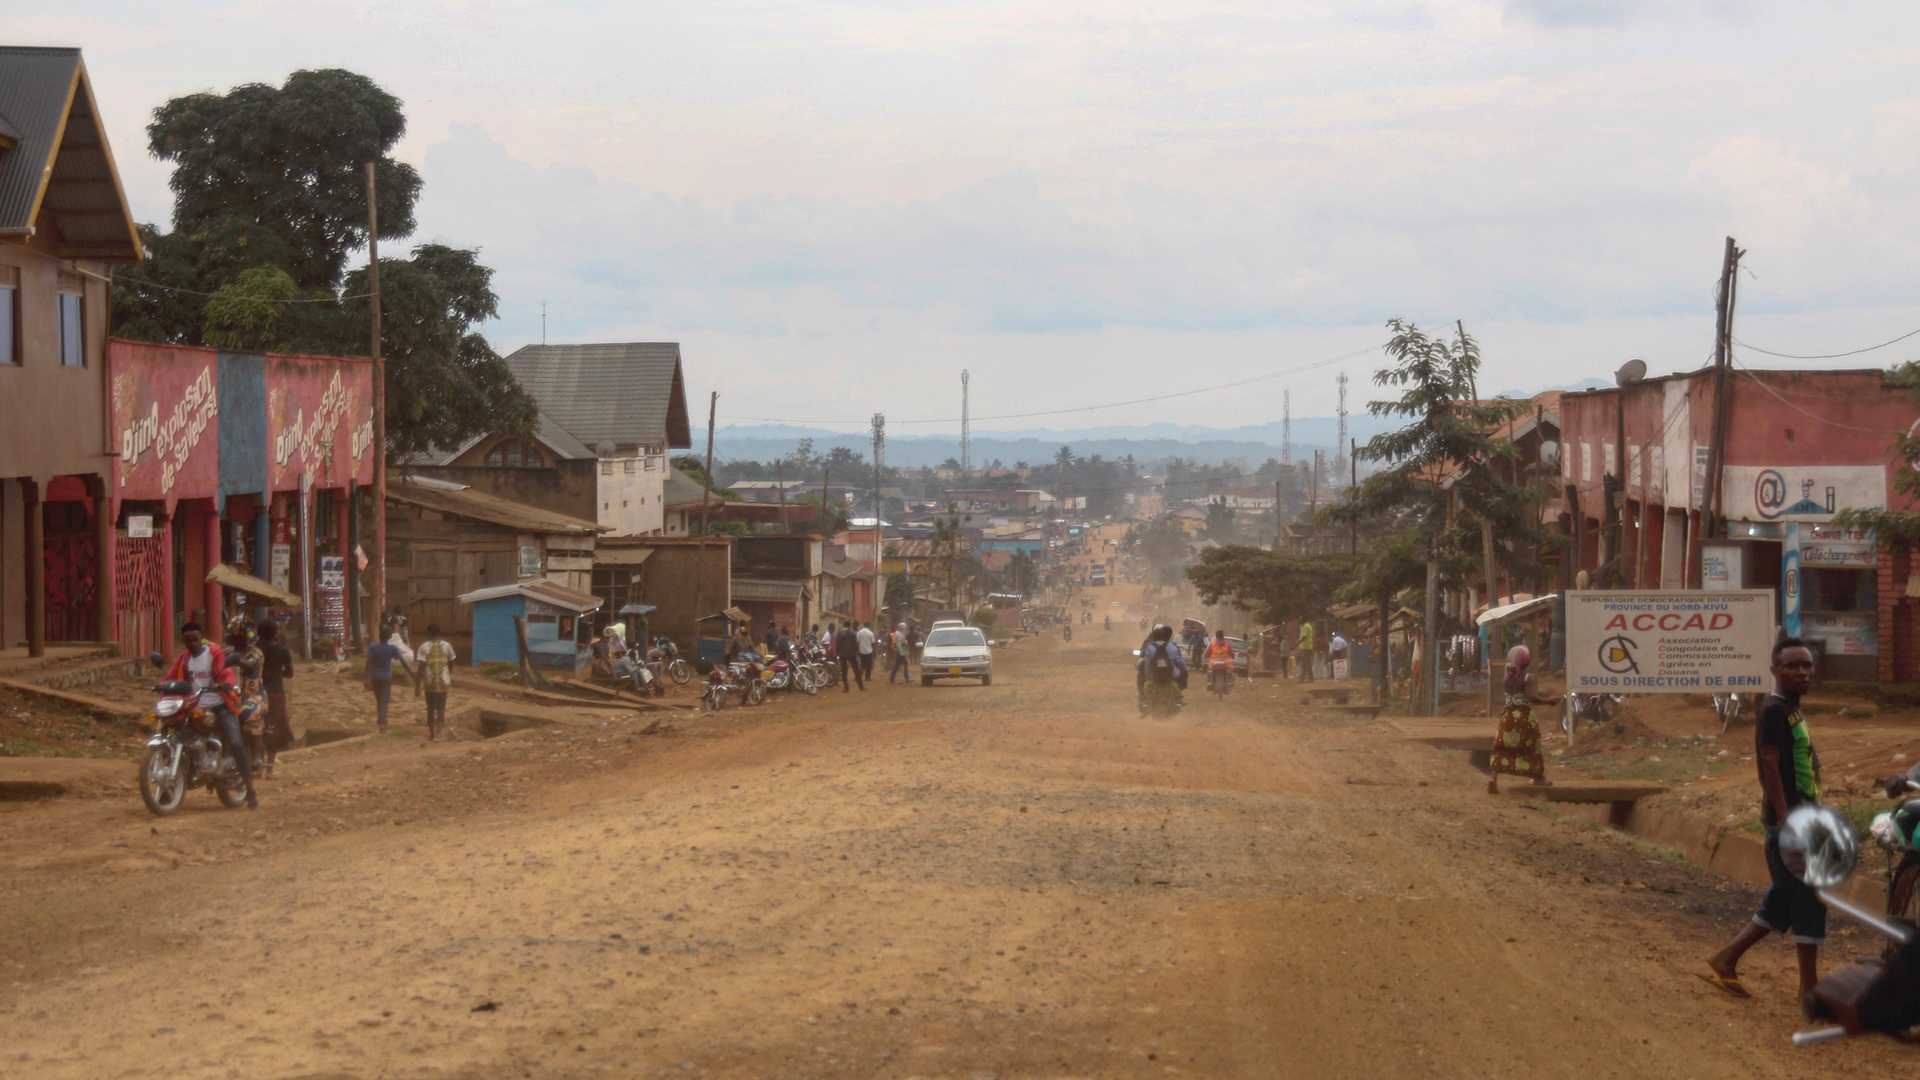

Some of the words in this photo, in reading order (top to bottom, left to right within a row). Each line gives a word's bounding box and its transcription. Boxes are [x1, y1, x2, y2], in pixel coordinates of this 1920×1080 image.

[156, 366, 212, 460] explosion
[301, 369, 342, 463] explosion
[161, 460, 175, 495] de
[1810, 530, 1842, 540] CHARGE
[1603, 613, 1734, 632] ACCAD
[1658, 645, 1718, 653] Congolaise
[1658, 661, 1695, 669] Agrées
[1580, 676, 1618, 686] SOUS
[1623, 676, 1700, 686] DIRECTION
[1705, 677, 1723, 686] DE
[1728, 676, 1762, 686] BENI
